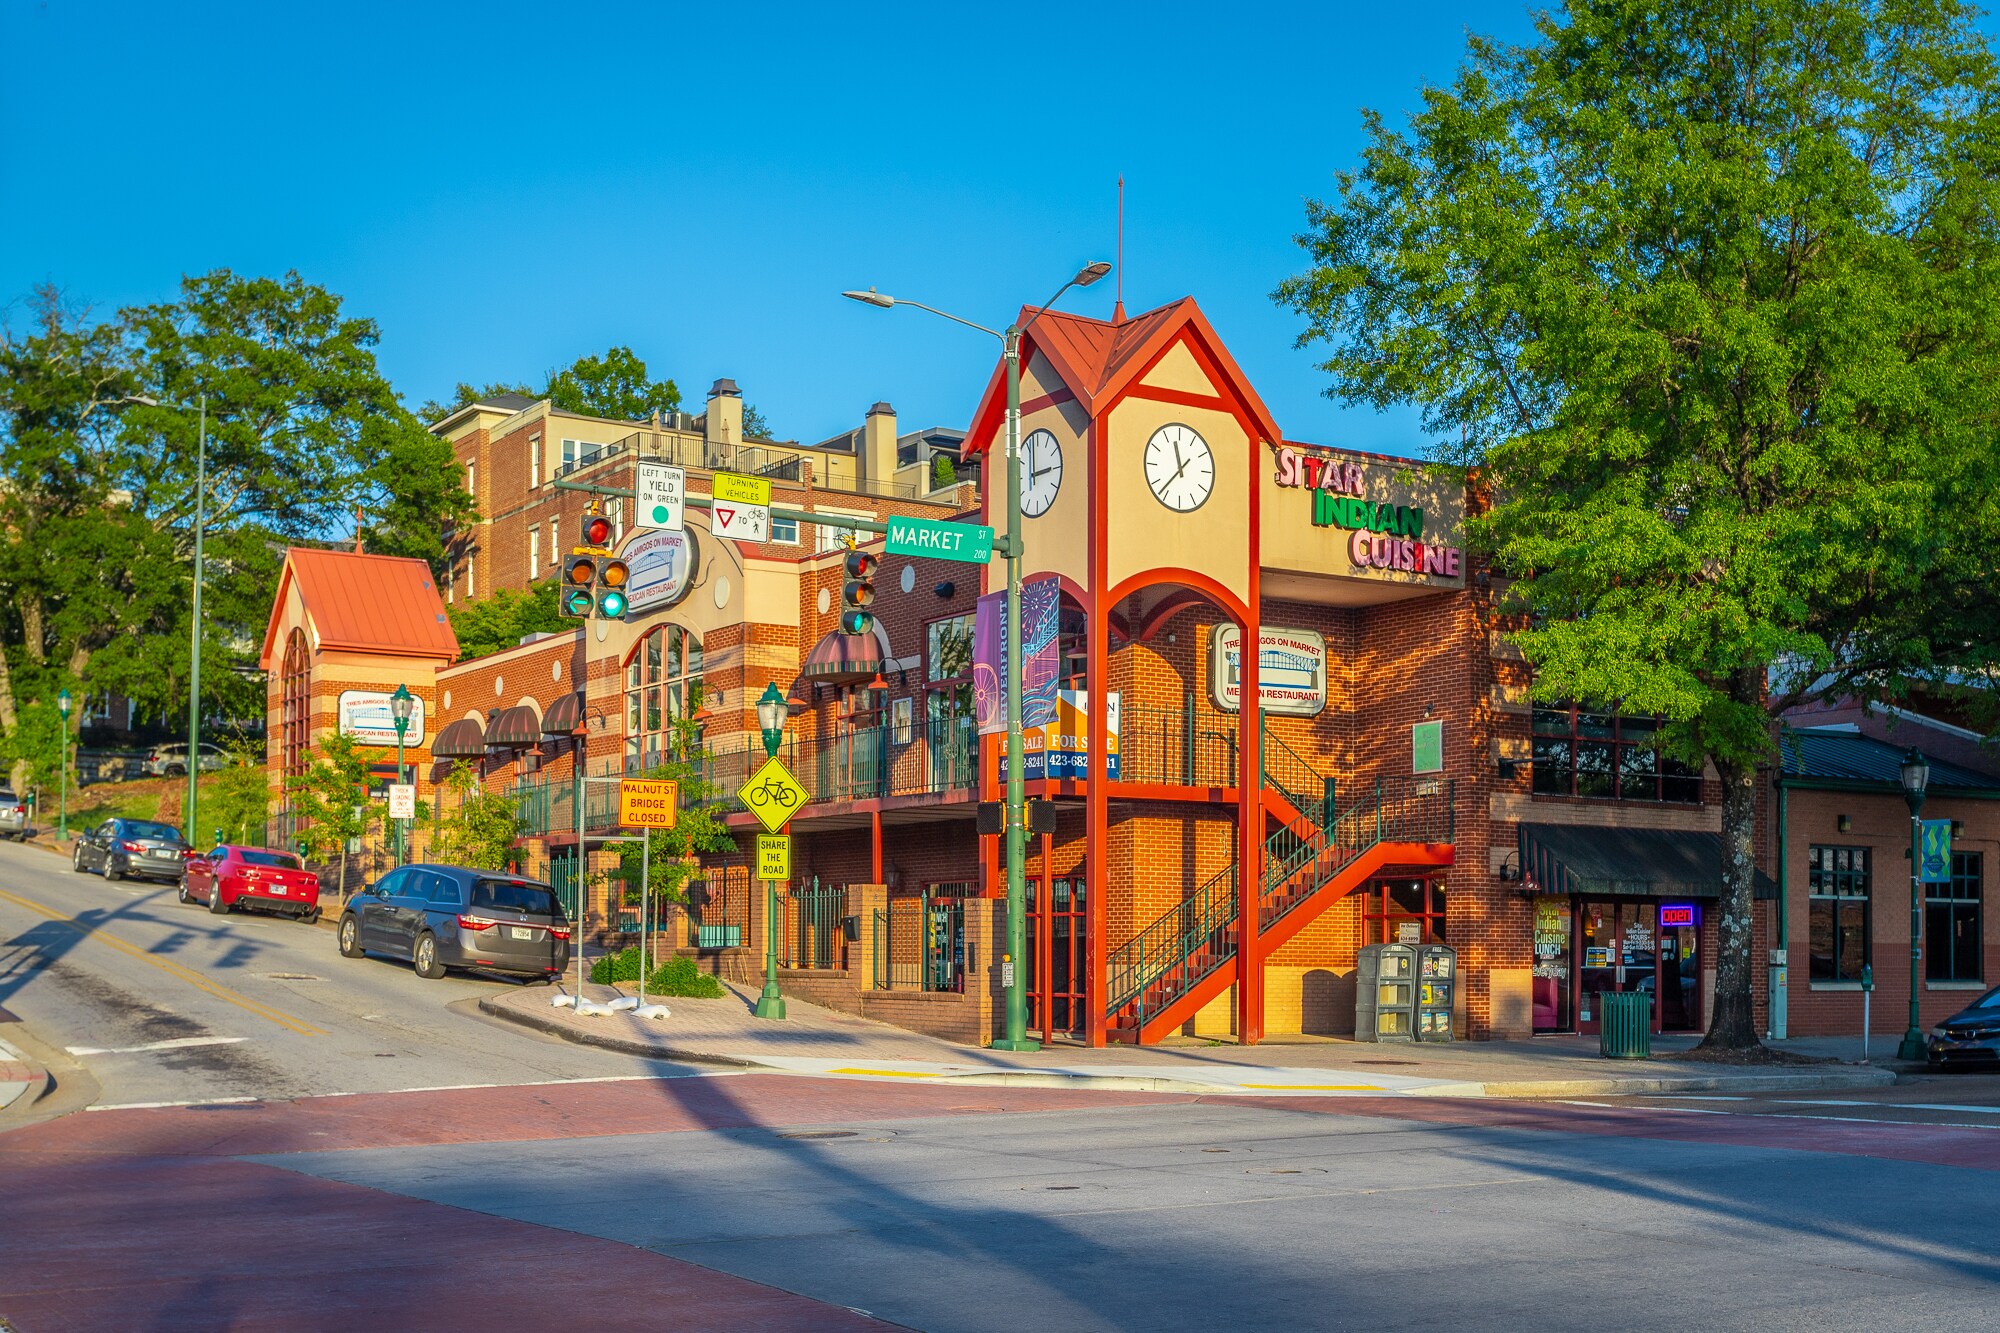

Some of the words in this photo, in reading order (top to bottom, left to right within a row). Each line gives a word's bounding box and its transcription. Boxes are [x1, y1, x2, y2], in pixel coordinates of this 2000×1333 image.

[642, 468, 659, 477] LEFT
[664, 471, 681, 480] TURN
[1276, 448, 1364, 495] SITAR
[649, 480, 674, 493] YIELD
[727, 478, 759, 490] TURNING
[643, 493, 652, 501] ON
[657, 494, 679, 504] GREEN
[725, 489, 760, 501] VEHICLES
[1312, 488, 1424, 537] INDIAN
[738, 516, 748, 525] TO
[891, 525, 964, 551] MARKET
[978, 529, 987, 540] ST
[633, 540, 653, 558] AMIGOS
[653, 538, 661, 547] ON
[662, 536, 683, 548] MARKET
[973, 549, 987, 559] 200
[1349, 530, 1460, 577] CUISINE
[627, 588, 646, 603] EXICAN
[646, 580, 677, 597] RESTAURANT
[1224, 639, 1241, 650] TRE
[1259, 636, 1276, 645] GOS
[1277, 638, 1289, 647] ON
[1289, 640, 1321, 657] MARKET
[1266, 689, 1320, 702] RESTAURANT
[1051, 734, 1078, 748] FOR
[1081, 737, 1114, 750] SE
[623, 784, 662, 794] WALNUT
[663, 786, 675, 795] ST
[630, 798, 665, 809] BRIDGE
[628, 812, 666, 823] CLOSED
[760, 840, 787, 850] SHARE
[766, 853, 781, 862] THE
[763, 865, 784, 875] ROAD
[1536, 915, 1562, 930] Indian
[1663, 909, 1691, 926] open
[1534, 929, 1566, 944] Cuisine
[1534, 944, 1560, 955] LUNCH
